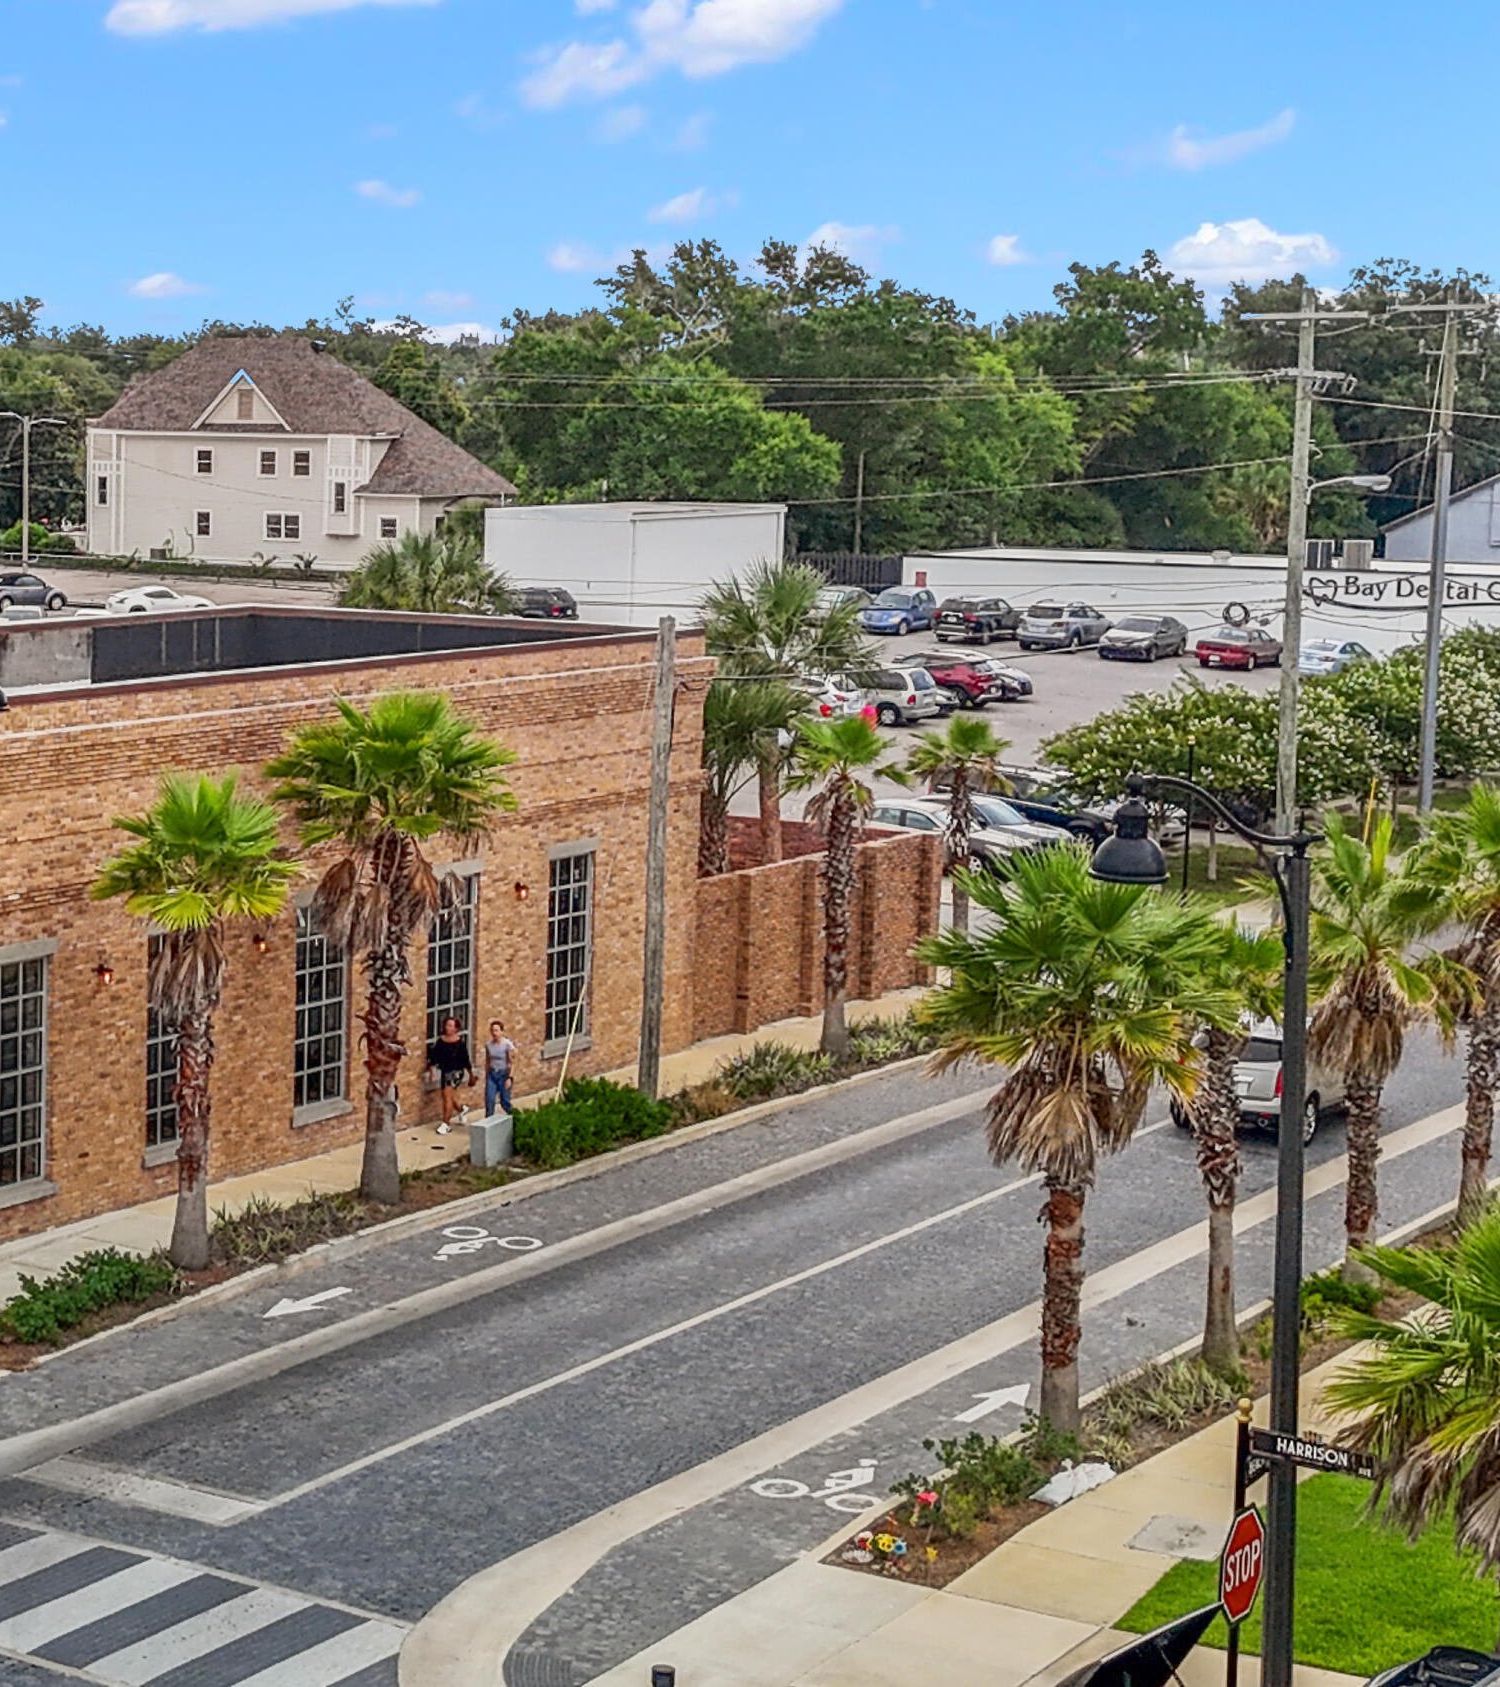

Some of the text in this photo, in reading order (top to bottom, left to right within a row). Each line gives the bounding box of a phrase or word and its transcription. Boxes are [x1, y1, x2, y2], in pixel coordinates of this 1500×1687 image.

[1344, 575, 1388, 601] Bay
[1395, 577, 1478, 600] Detal
[1276, 1437, 1348, 1468] HARRISON
[1224, 1539, 1261, 1593] STOP
